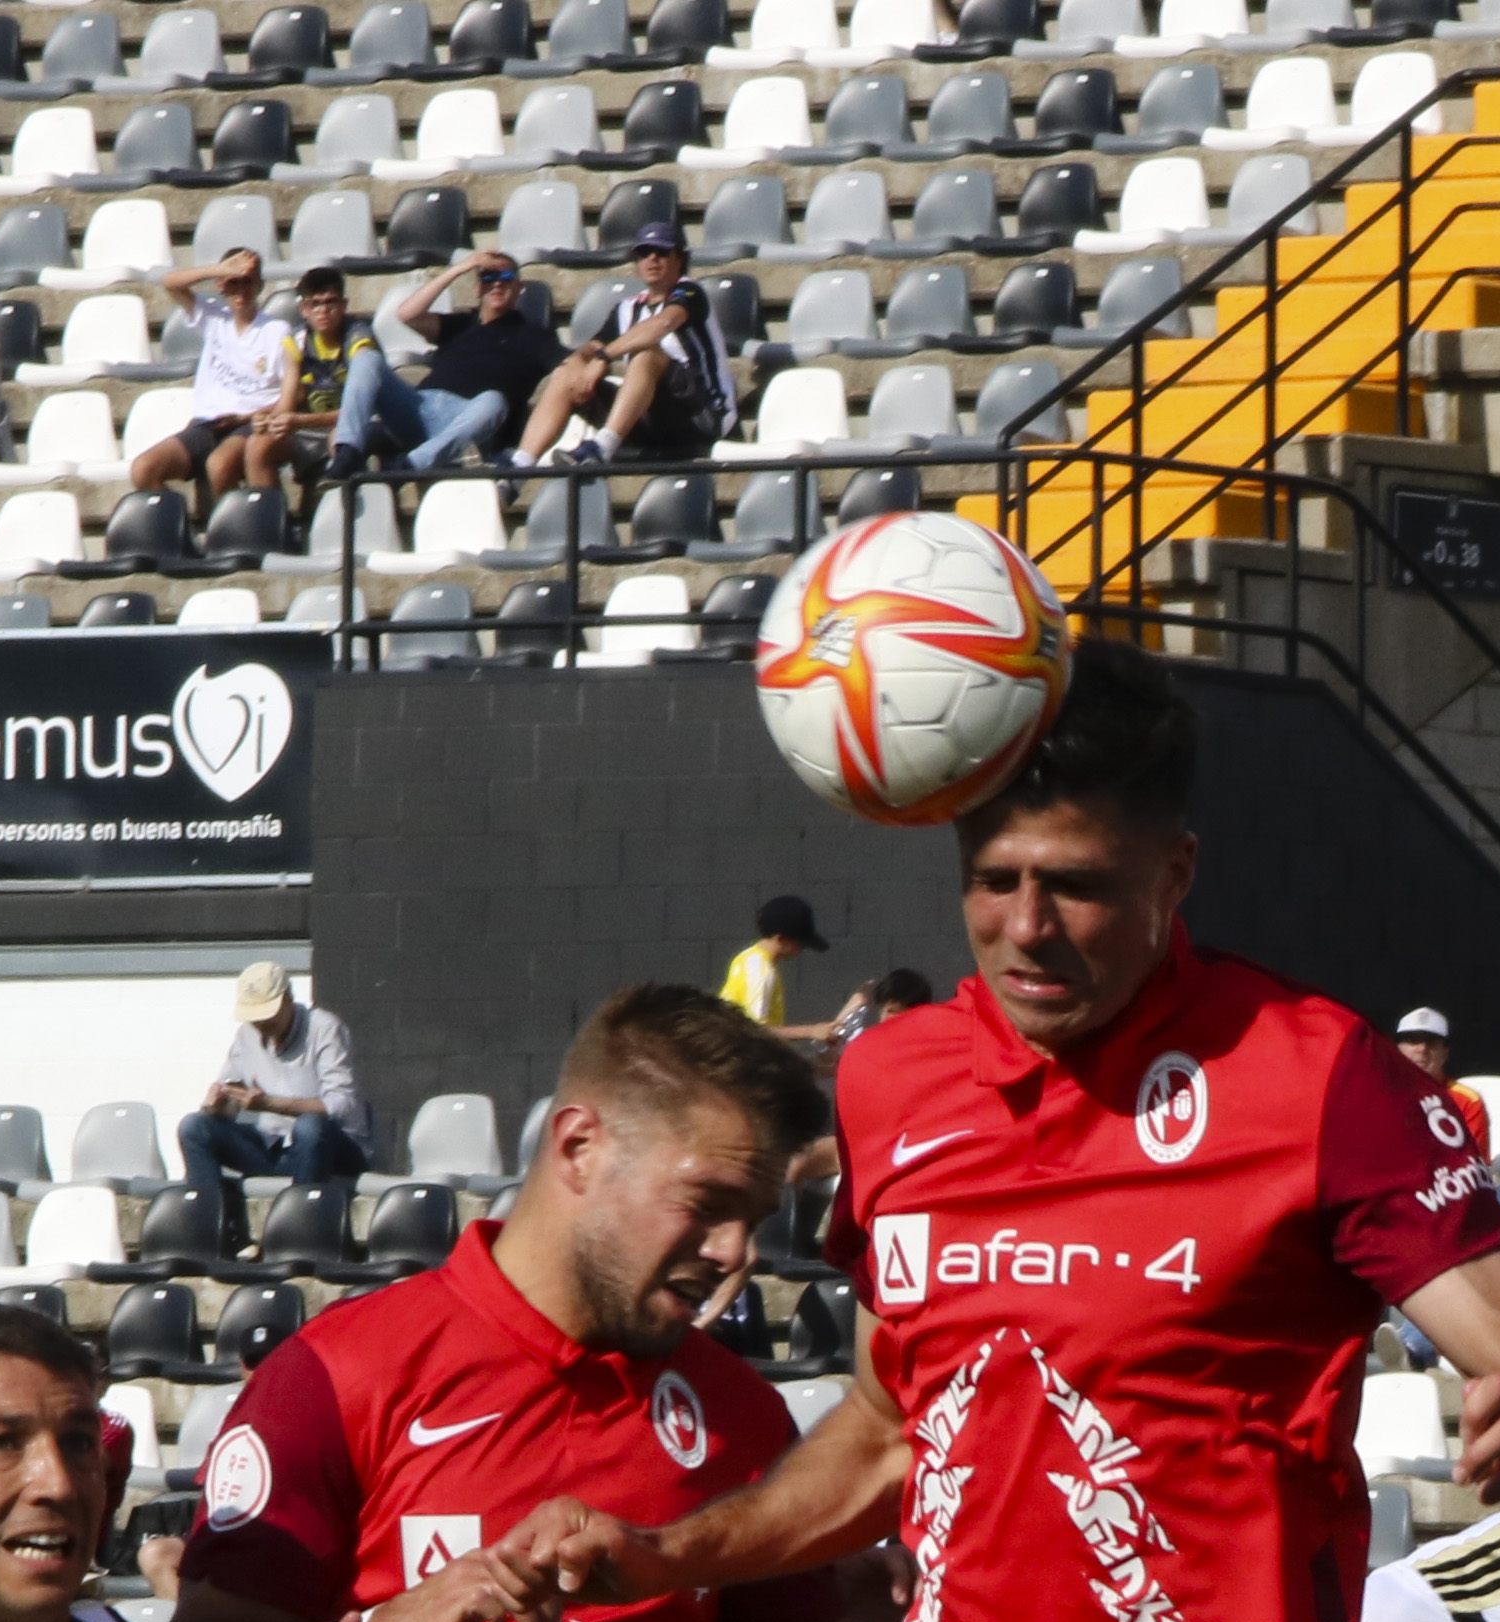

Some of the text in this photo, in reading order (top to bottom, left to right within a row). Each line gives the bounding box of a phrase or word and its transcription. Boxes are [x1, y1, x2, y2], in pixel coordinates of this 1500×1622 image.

[91, 824, 117, 842] en
[121, 817, 183, 842] buena
[186, 814, 283, 843] compañía
[936, 1228, 1100, 1286] afar
